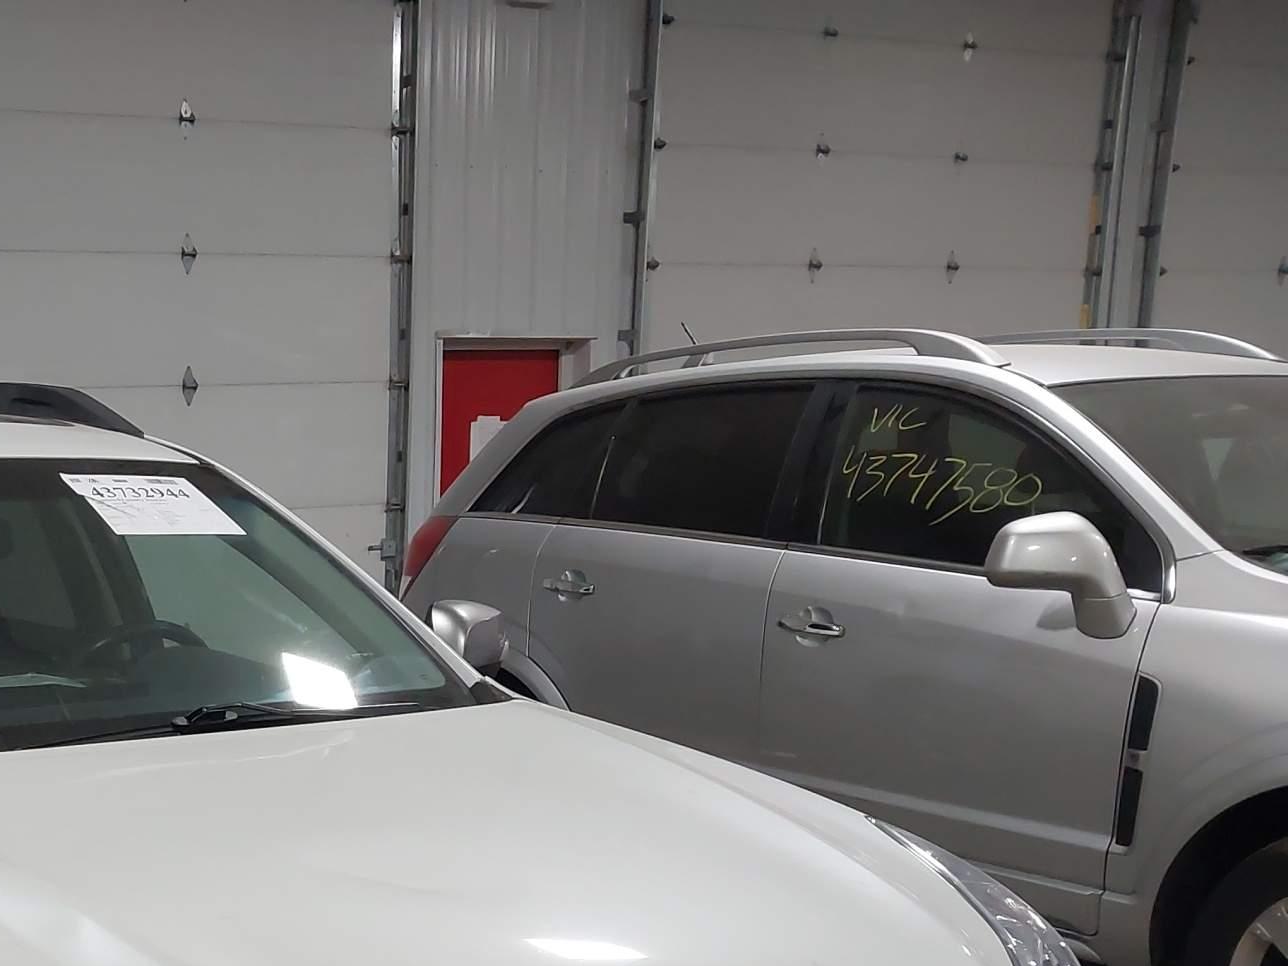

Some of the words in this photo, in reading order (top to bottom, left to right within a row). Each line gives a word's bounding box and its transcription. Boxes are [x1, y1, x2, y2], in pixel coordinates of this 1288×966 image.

[870, 403, 927, 433] VIC
[91, 486, 190, 498] 43732944
[842, 445, 1043, 526] 43747580
